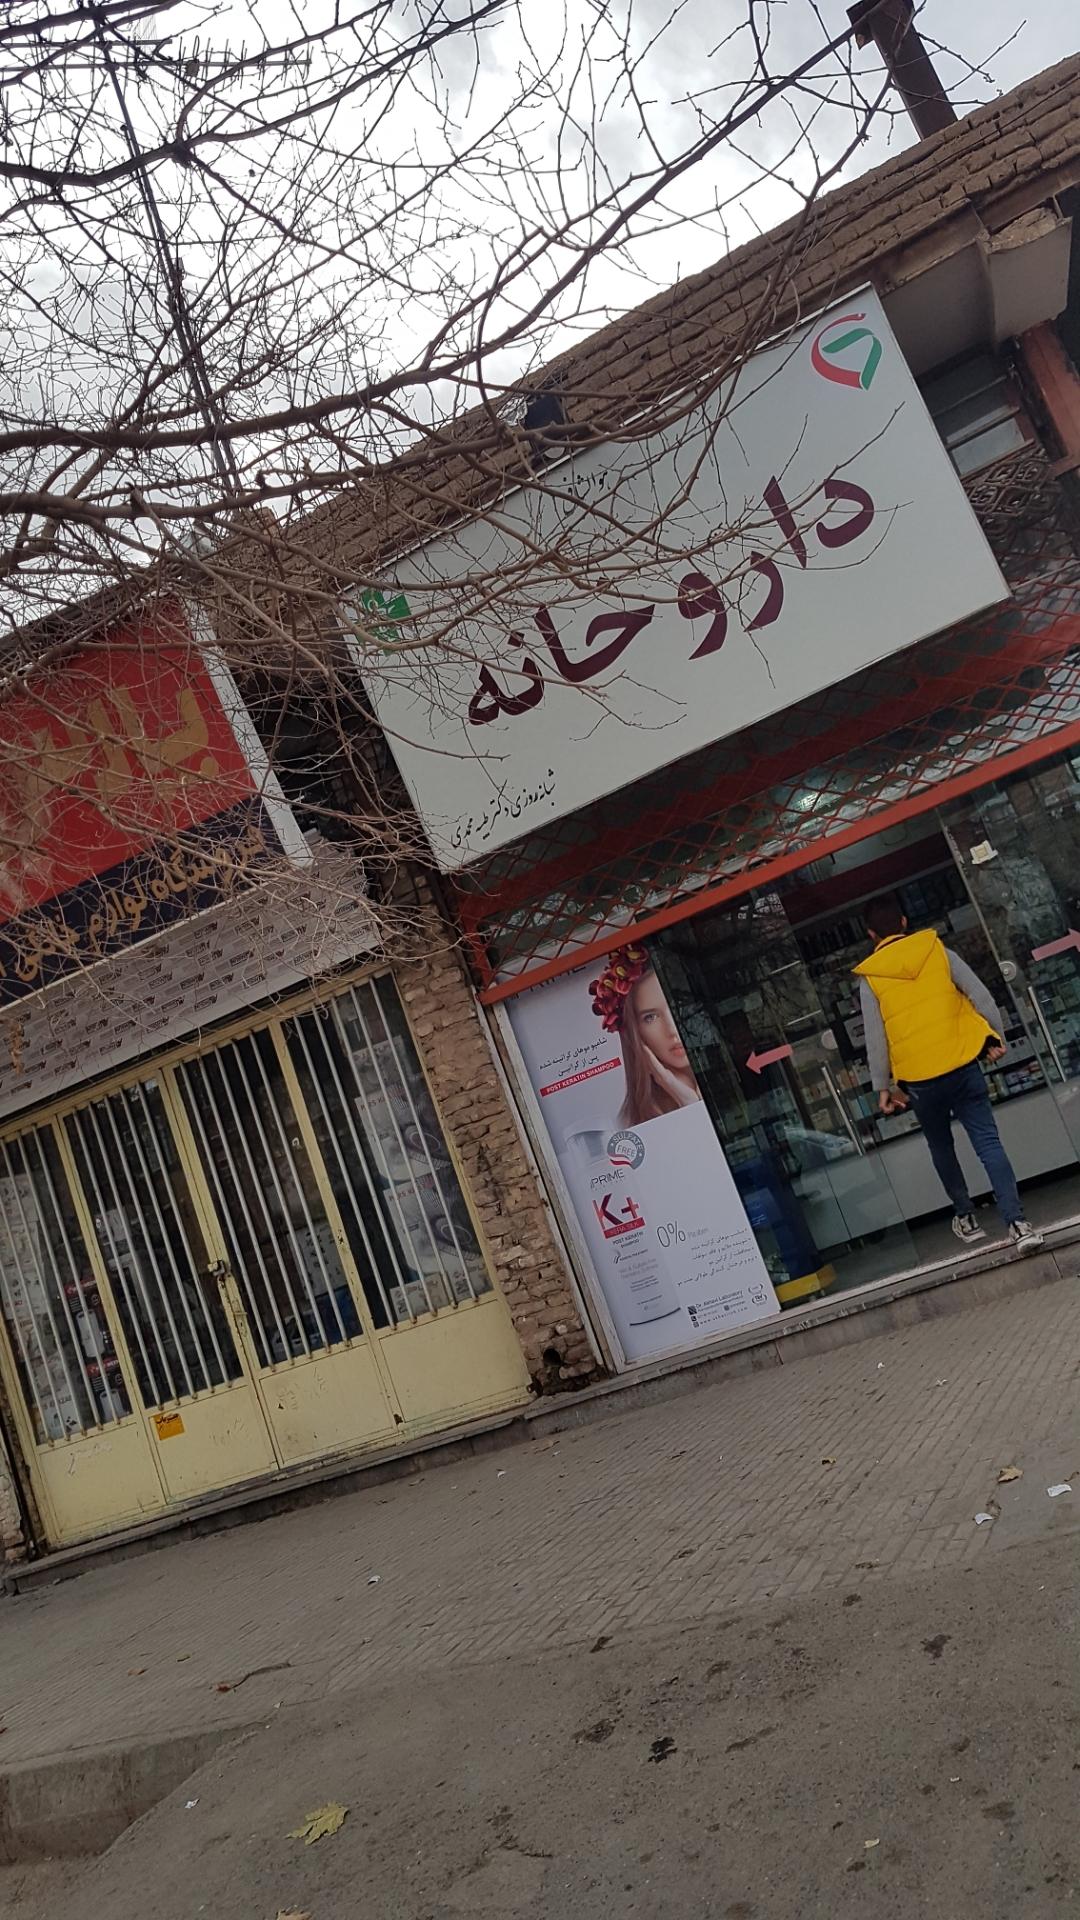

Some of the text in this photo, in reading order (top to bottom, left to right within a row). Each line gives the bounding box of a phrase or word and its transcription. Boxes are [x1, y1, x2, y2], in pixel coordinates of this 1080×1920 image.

[547, 1061, 615, 1094] POST KERATIN SHAMPOO
[616, 1144, 636, 1158] FREE
[590, 1168, 625, 1190] PRIME
[592, 1192, 640, 1230] K+
[656, 1220, 686, 1248] 0%
